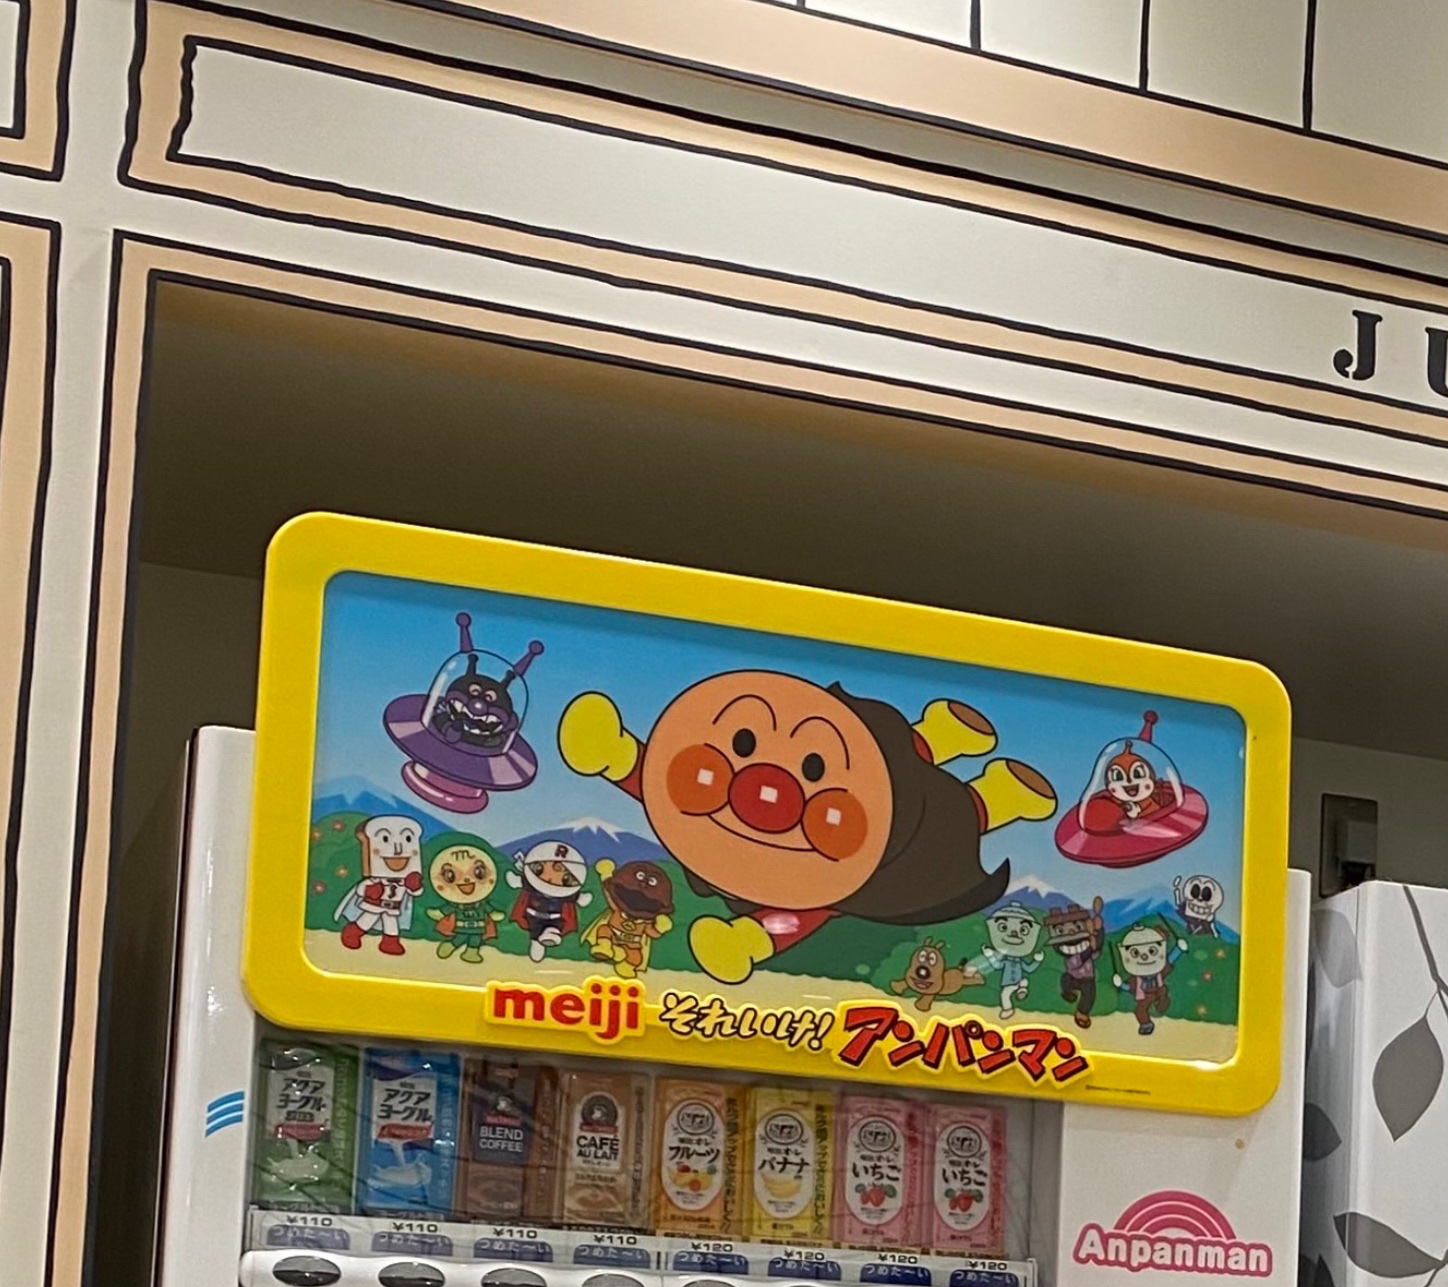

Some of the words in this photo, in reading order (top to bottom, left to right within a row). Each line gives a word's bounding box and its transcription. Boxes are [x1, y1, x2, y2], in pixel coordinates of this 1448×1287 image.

[492, 982, 643, 1039] meiji
[839, 1005, 1090, 1080] アンパンマン
[383, 1088, 430, 1104] アクア
[480, 1126, 523, 1140] BLEND
[479, 1139, 522, 1153] COFFEE
[758, 1157, 810, 1174] バナナ
[852, 1162, 900, 1182] いちご
[941, 1167, 988, 1187] いちご
[286, 1215, 333, 1227] ¥110
[393, 1222, 438, 1233] ¥110
[493, 1228, 537, 1239] ¥110
[593, 1235, 637, 1245] ¥110
[691, 1241, 734, 1253] ¥120
[1076, 1226, 1270, 1274] Anpanman
[785, 1250, 825, 1261] ¥120
[878, 1253, 918, 1264] ¥120
[969, 1261, 1008, 1271] ¥120
